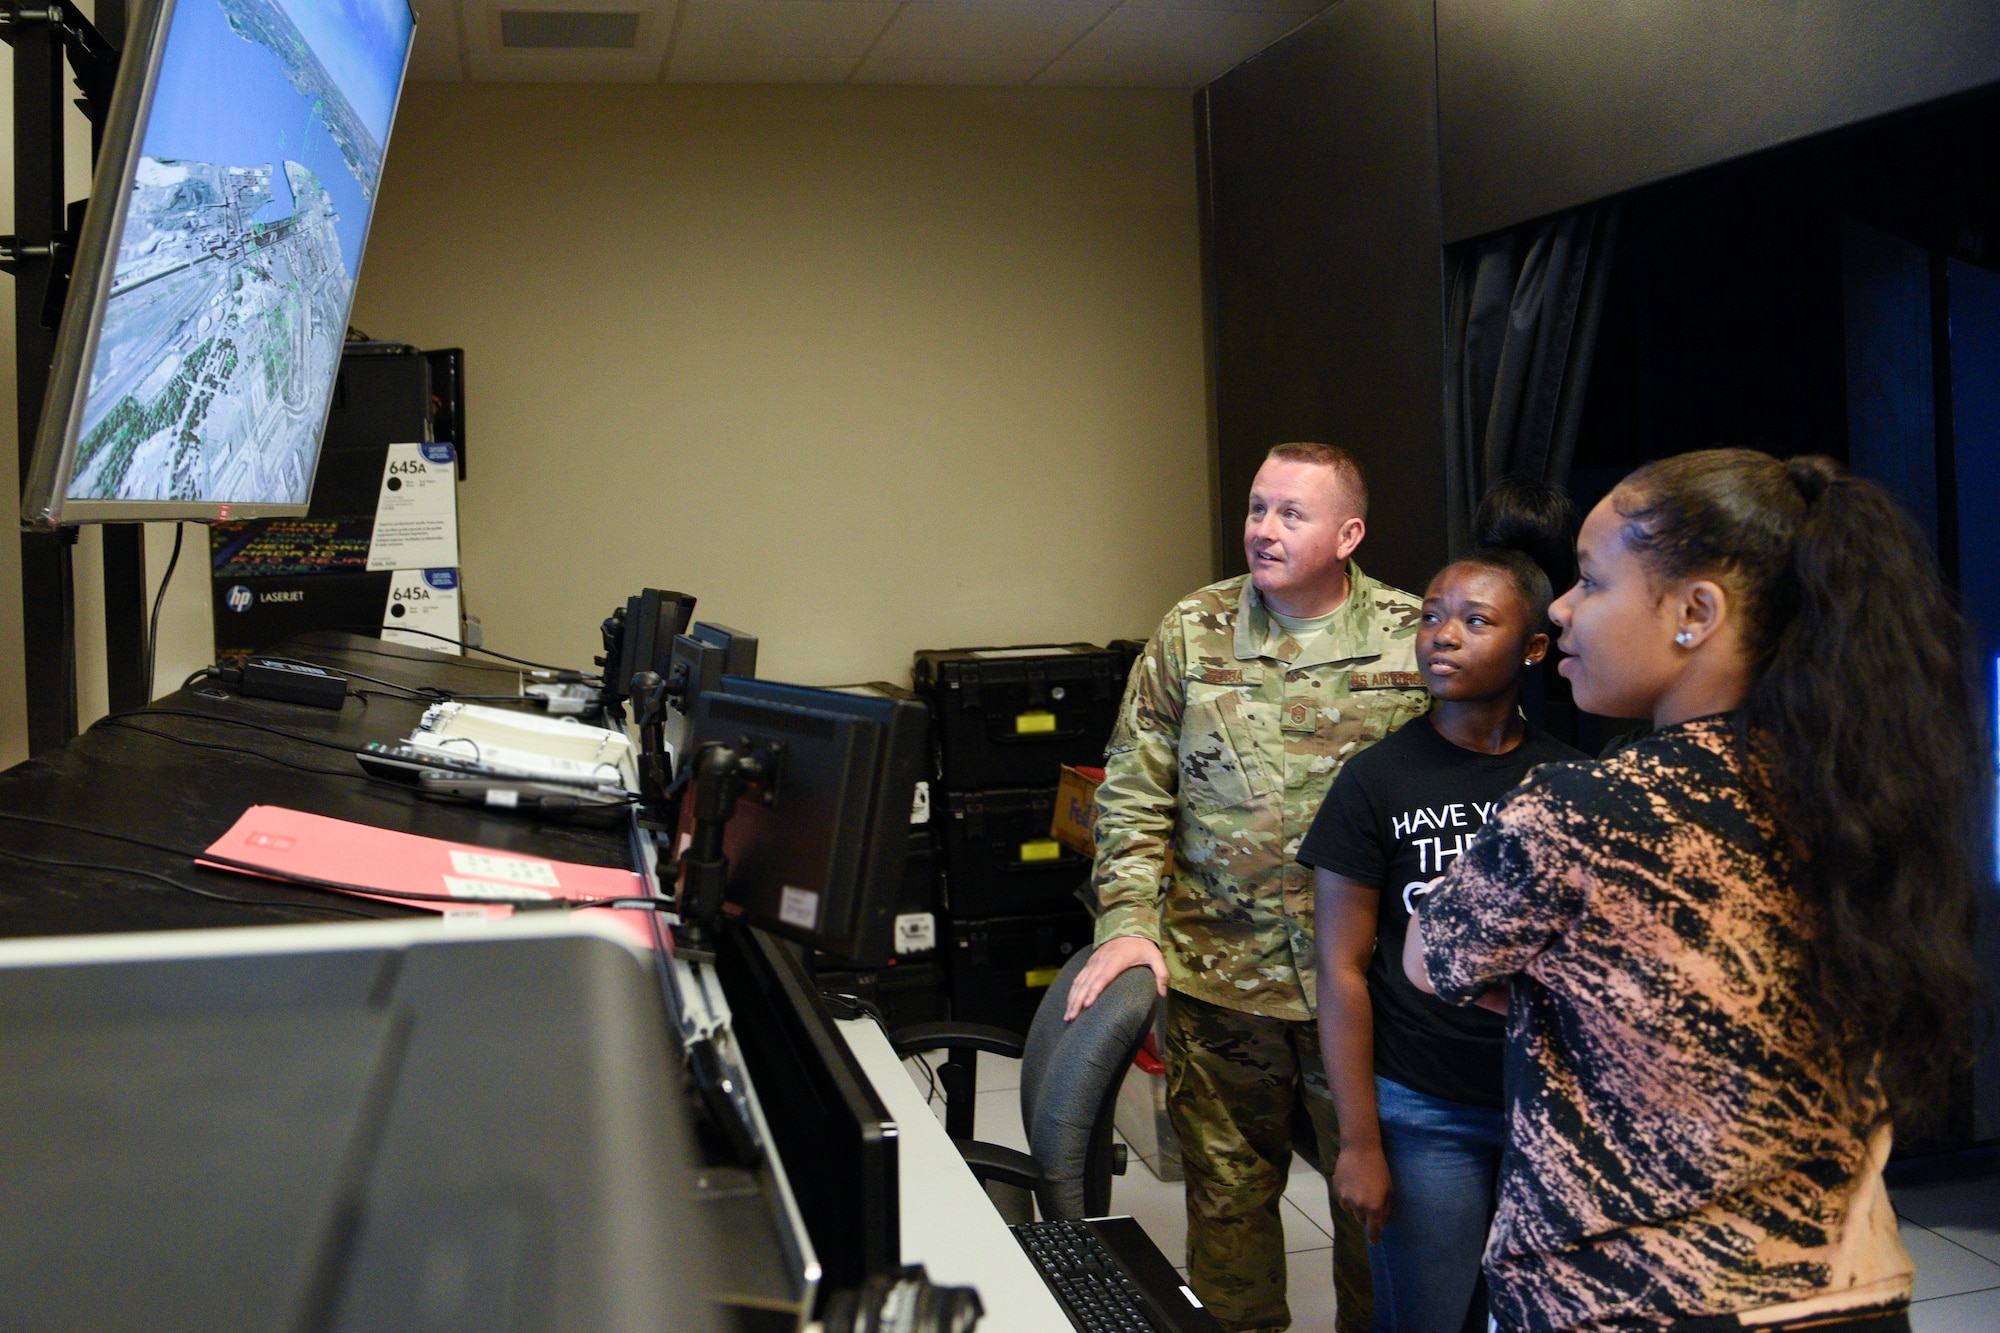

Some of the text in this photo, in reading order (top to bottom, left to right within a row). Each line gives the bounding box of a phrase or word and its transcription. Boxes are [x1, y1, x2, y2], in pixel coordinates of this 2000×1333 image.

[389, 460, 427, 475] 645A
[230, 556, 284, 565] RIO
[238, 550, 336, 558] MADRID
[229, 585, 250, 612] hp
[260, 590, 304, 603] LASERJET
[392, 586, 430, 601] 645A
[1372, 672, 1390, 686] AIR
[1391, 803, 1468, 840] HAVE
